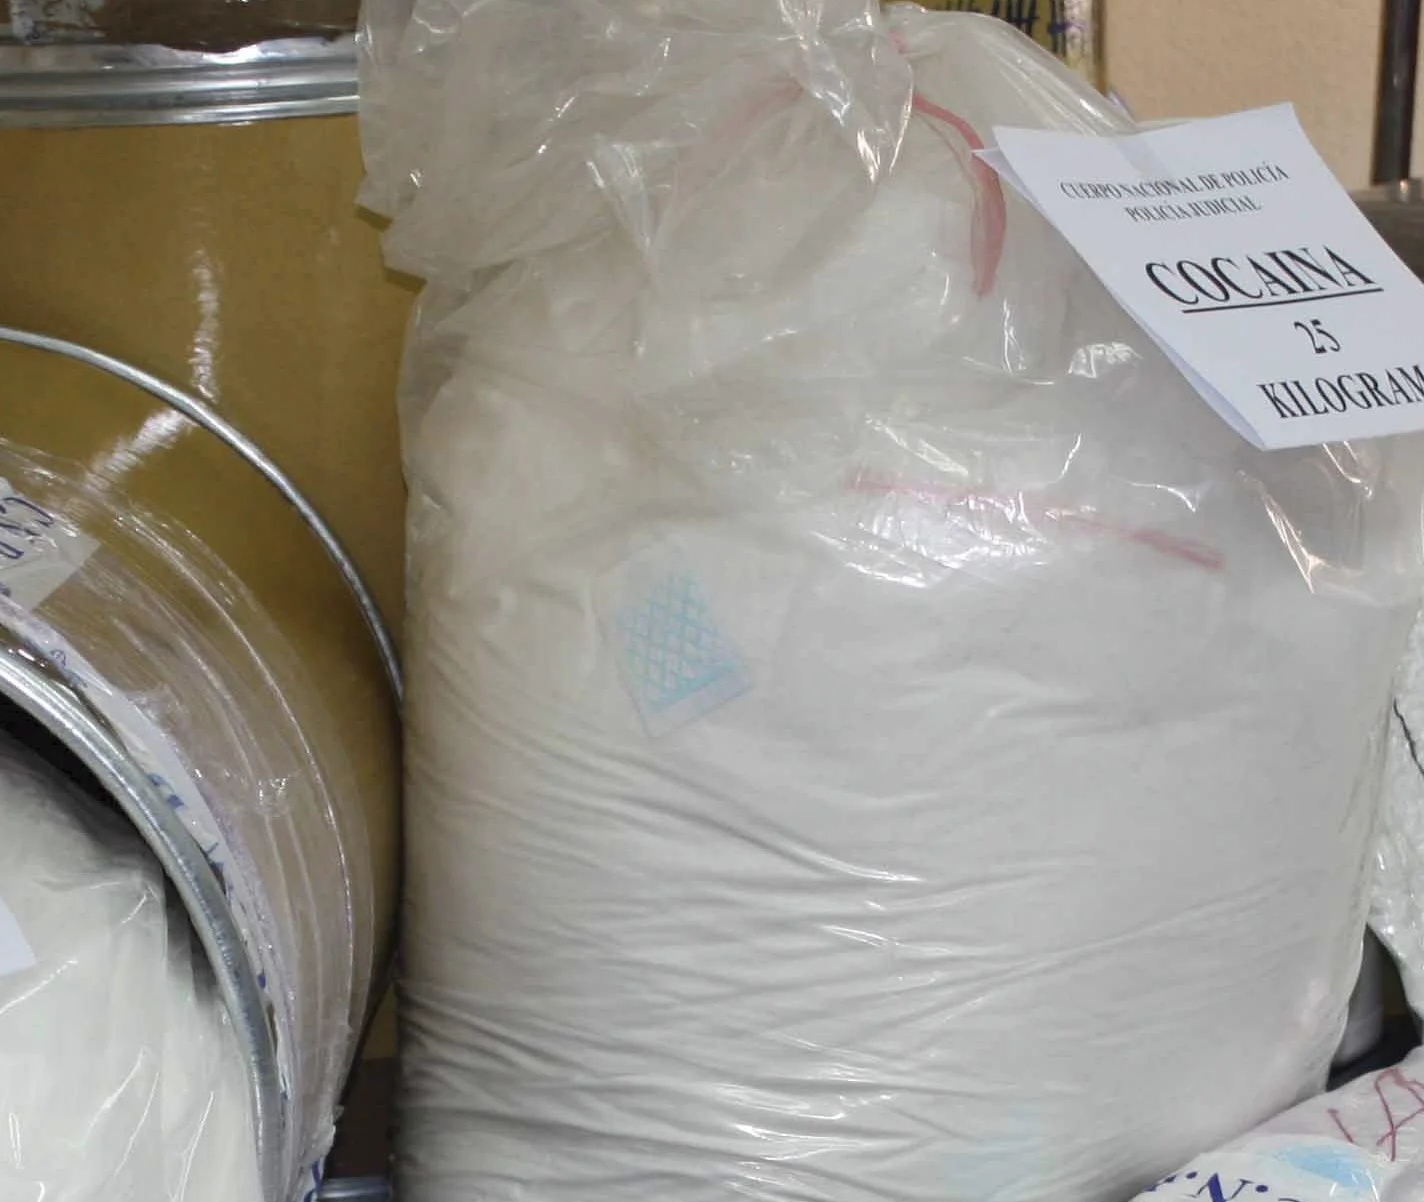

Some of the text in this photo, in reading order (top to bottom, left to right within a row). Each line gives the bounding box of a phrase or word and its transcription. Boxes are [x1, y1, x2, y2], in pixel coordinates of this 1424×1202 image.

[1060, 161, 1289, 199] CUERPO NACIONAL DE POLICÍA
[1124, 195, 1261, 222] POLICÍA JUDICIAL
[1145, 245, 1375, 307] COCAINA
[1294, 319, 1341, 355] 25
